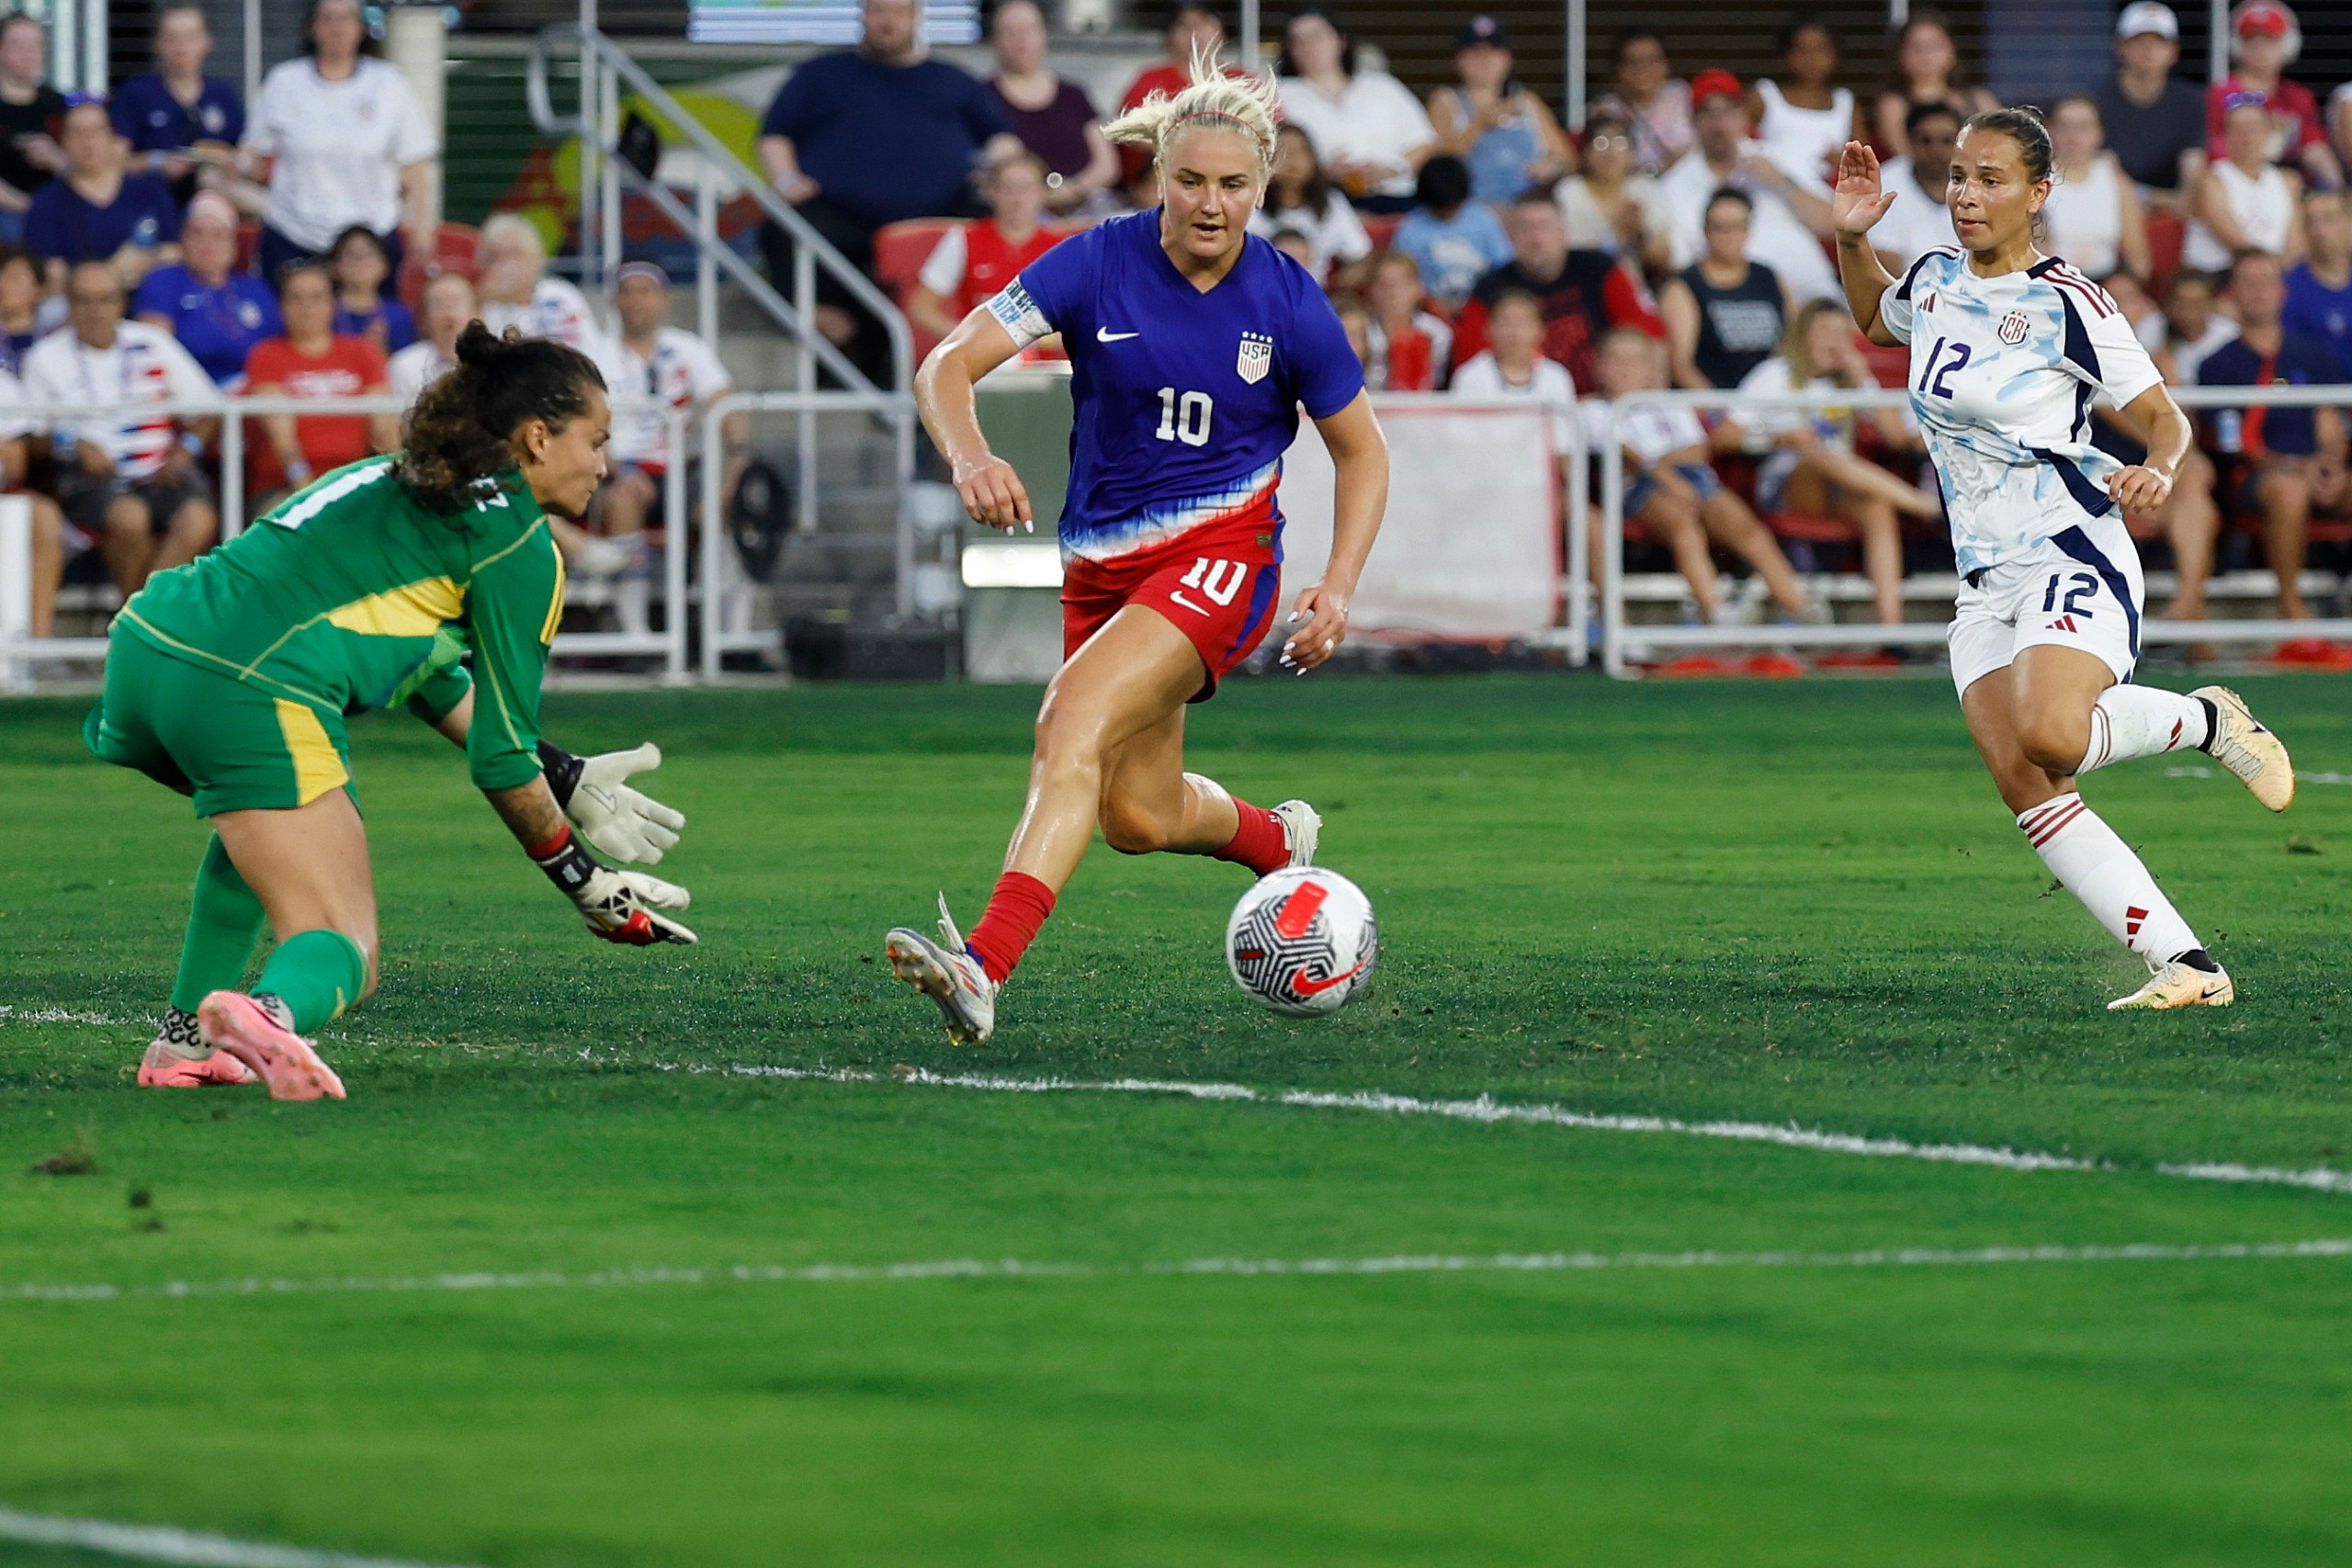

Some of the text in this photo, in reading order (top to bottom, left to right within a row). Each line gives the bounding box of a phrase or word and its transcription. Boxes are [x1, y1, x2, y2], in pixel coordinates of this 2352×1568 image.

[1242, 343, 1270, 360] USA
[2004, 317, 2025, 340] CR
[1918, 336, 1972, 400] 12
[1156, 387, 1213, 447] 10
[1180, 557, 1248, 606] 10
[2042, 572, 2098, 619] 12
